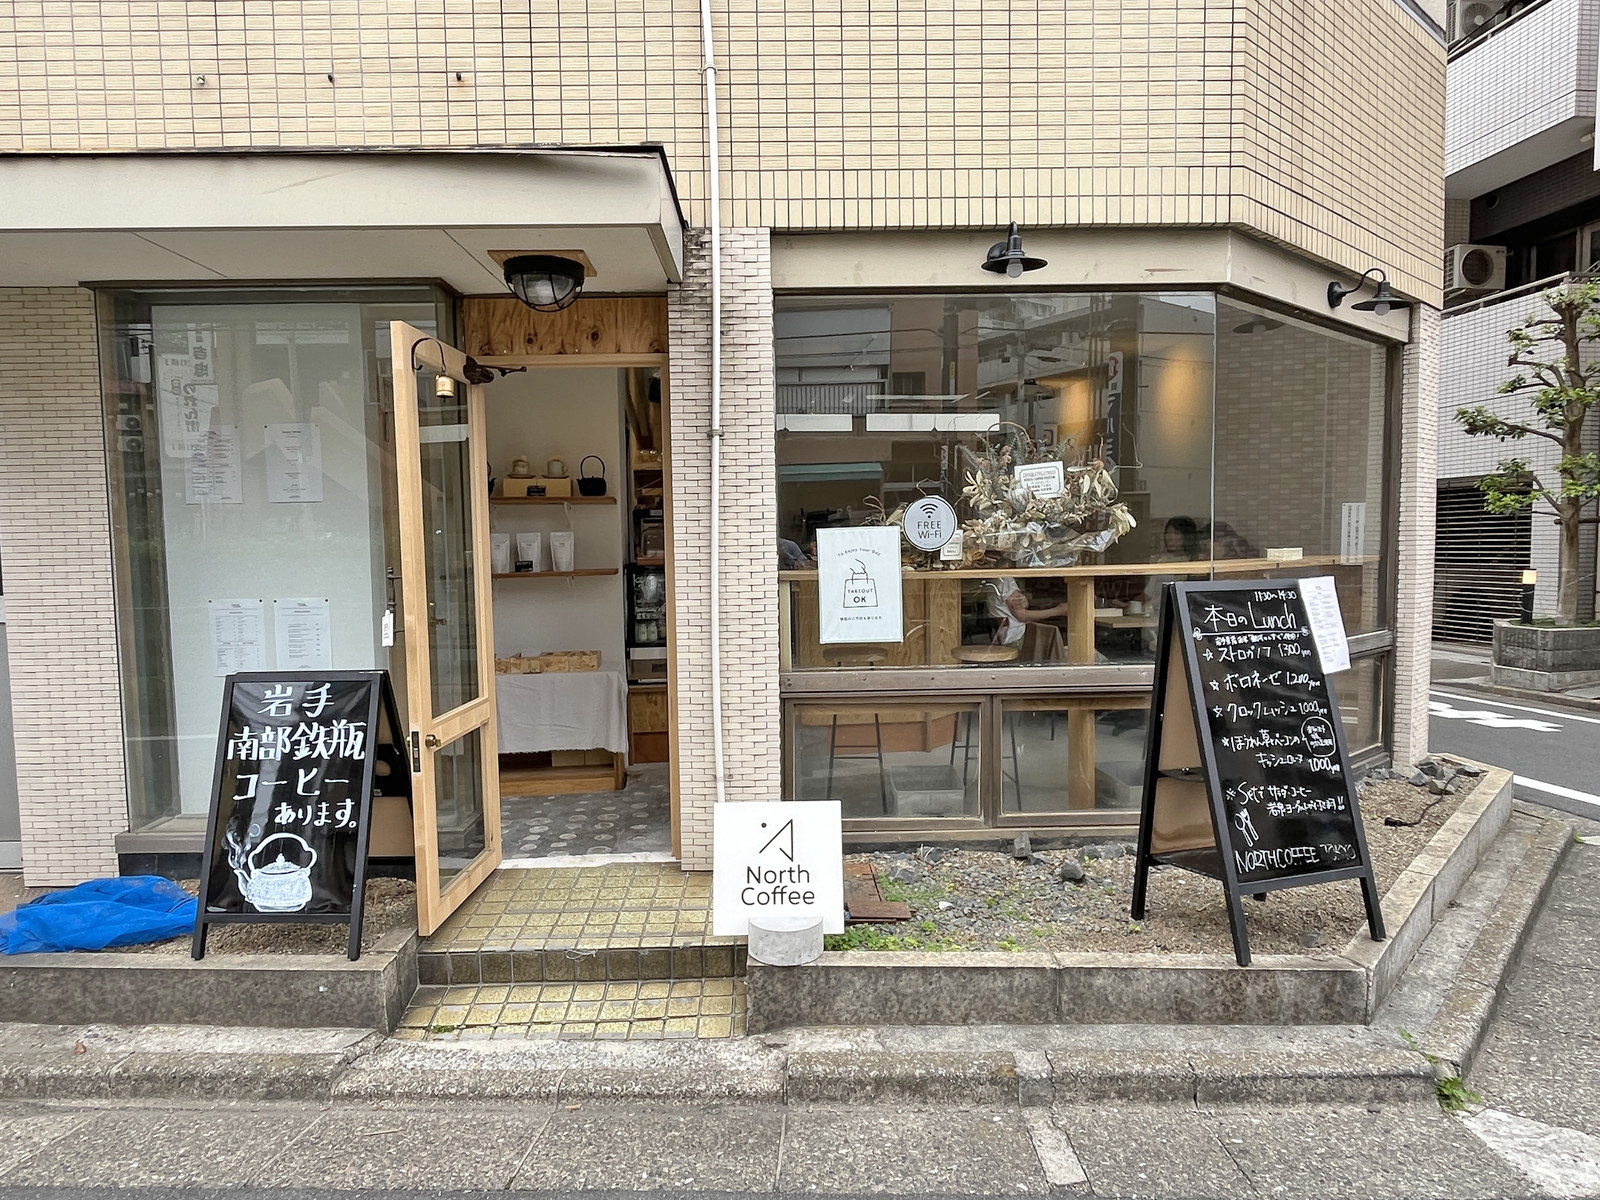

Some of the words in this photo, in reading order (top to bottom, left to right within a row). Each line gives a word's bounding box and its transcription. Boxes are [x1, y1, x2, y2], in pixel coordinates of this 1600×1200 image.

[917, 521, 942, 529] FREE
[918, 530, 942, 539] Wi-Fi
[853, 596, 867, 604] OK
[1248, 601, 1297, 629] Lunch
[1218, 645, 1272, 663] ストロガノフ
[1224, 670, 1282, 692] ボロネーゼ
[258, 682, 335, 718] 岩手
[227, 719, 367, 761] 南部鉄瓶
[232, 768, 350, 801] コーヒー
[274, 798, 358, 829] あります。
[746, 864, 811, 884] North
[741, 885, 815, 906] Coffee
